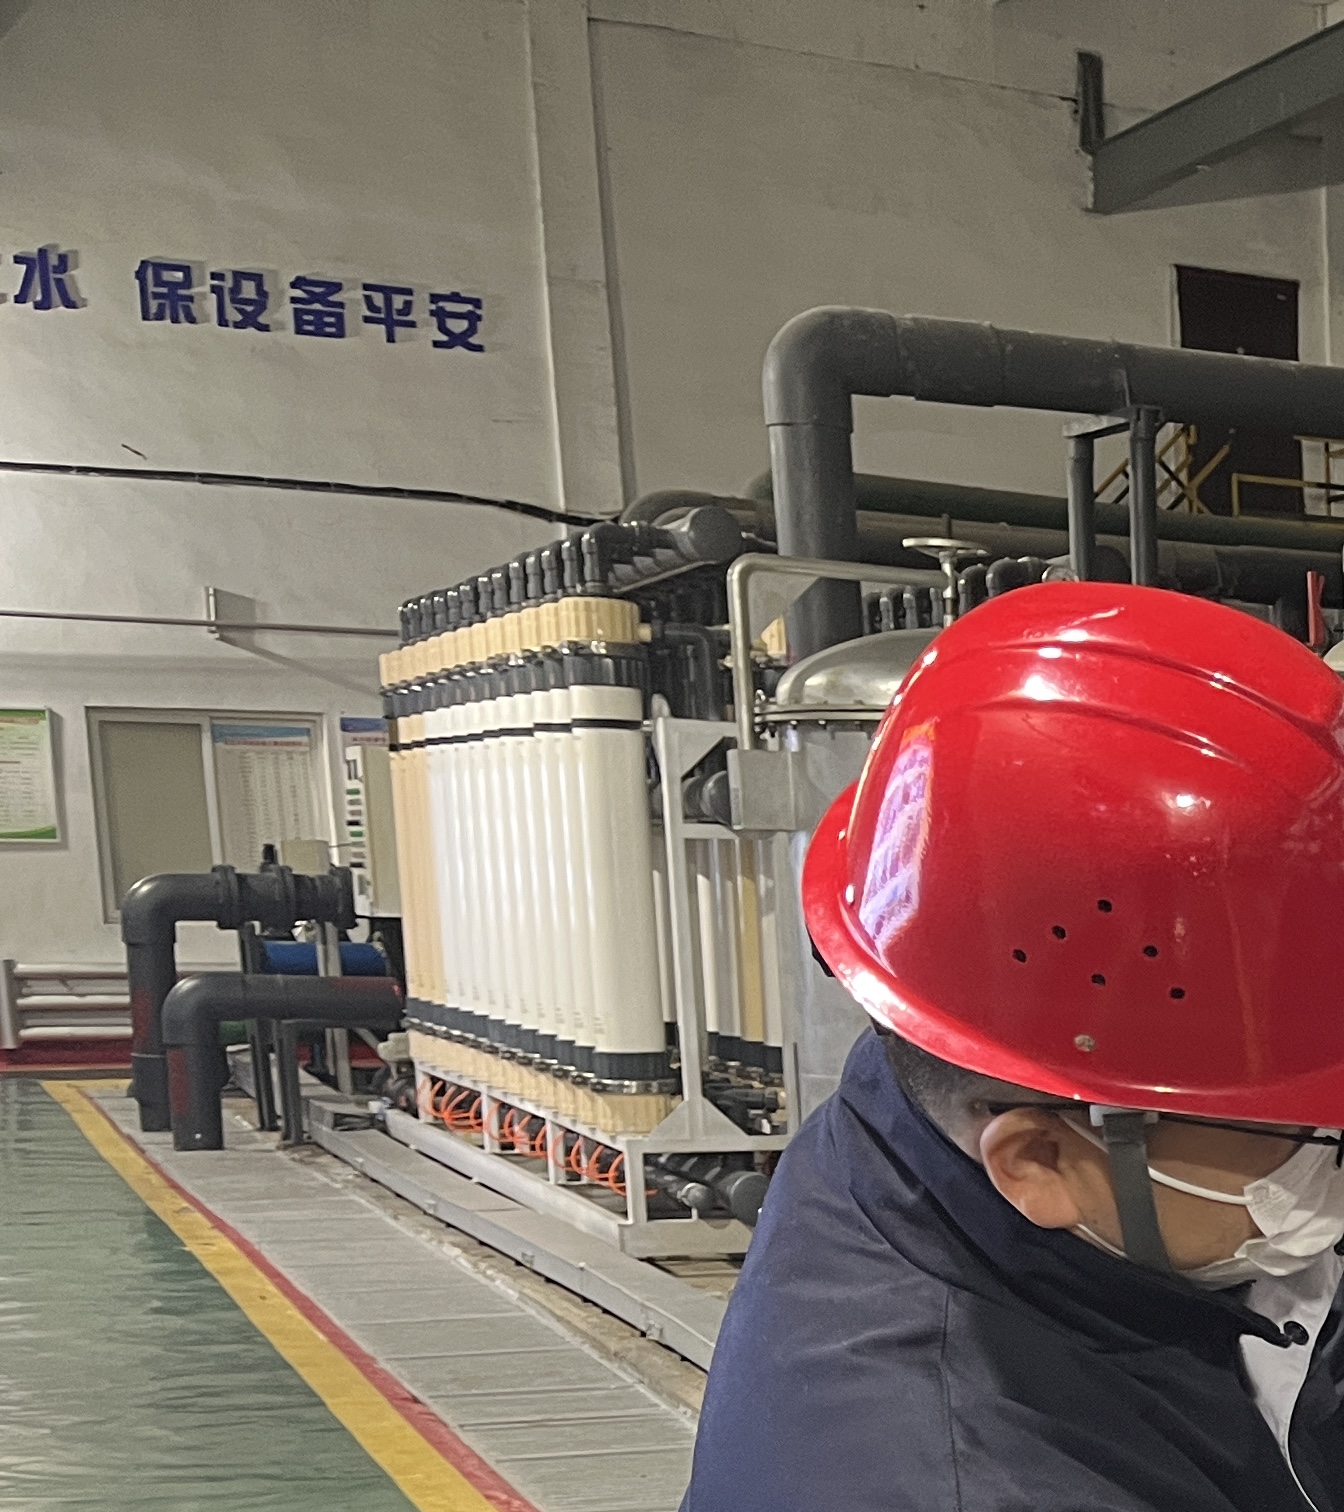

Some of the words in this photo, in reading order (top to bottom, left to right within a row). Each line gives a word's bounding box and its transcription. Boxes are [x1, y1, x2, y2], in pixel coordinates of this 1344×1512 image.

[0, 246, 80, 311] 水
[134, 257, 486, 353] 保设备平安
